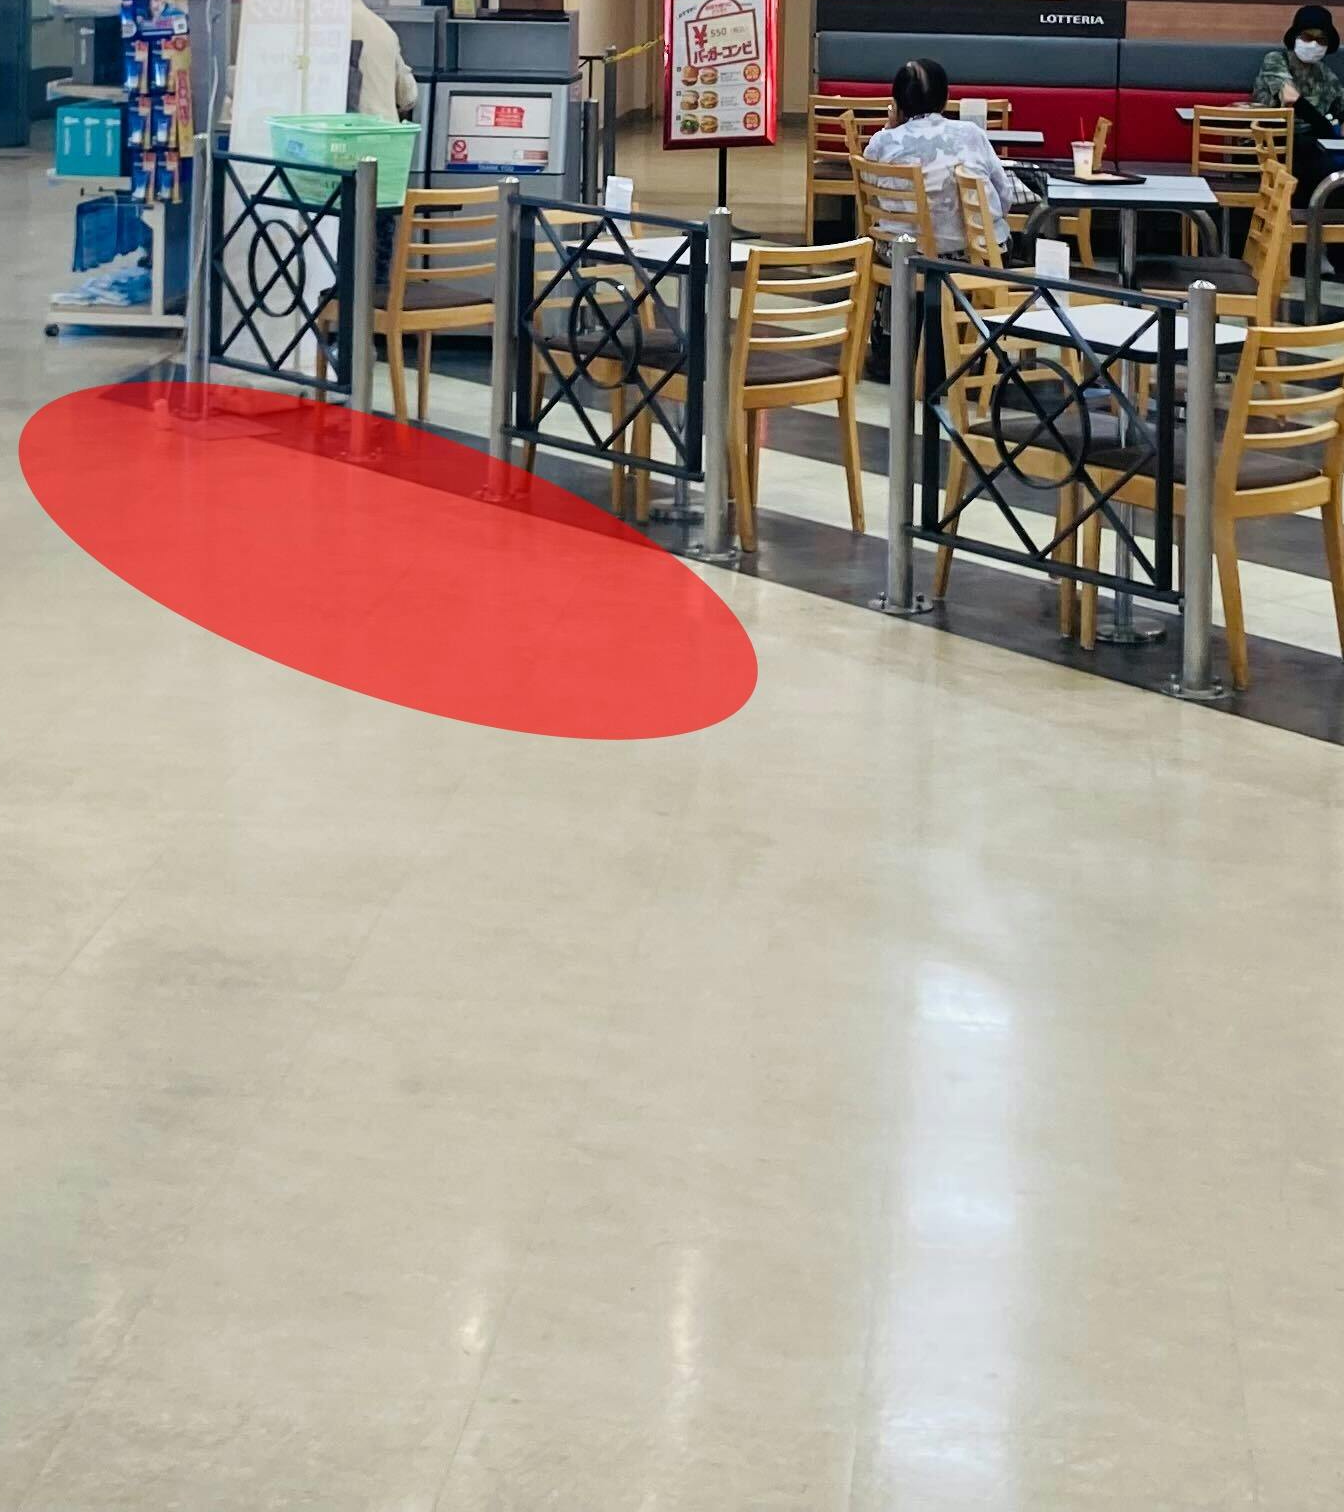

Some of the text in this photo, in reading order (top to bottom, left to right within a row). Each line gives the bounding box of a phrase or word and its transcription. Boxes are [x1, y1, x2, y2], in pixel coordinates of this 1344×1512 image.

[1039, 14, 1105, 25] LOTTERIA
[694, 40, 753, 64] バーガーコンビ
